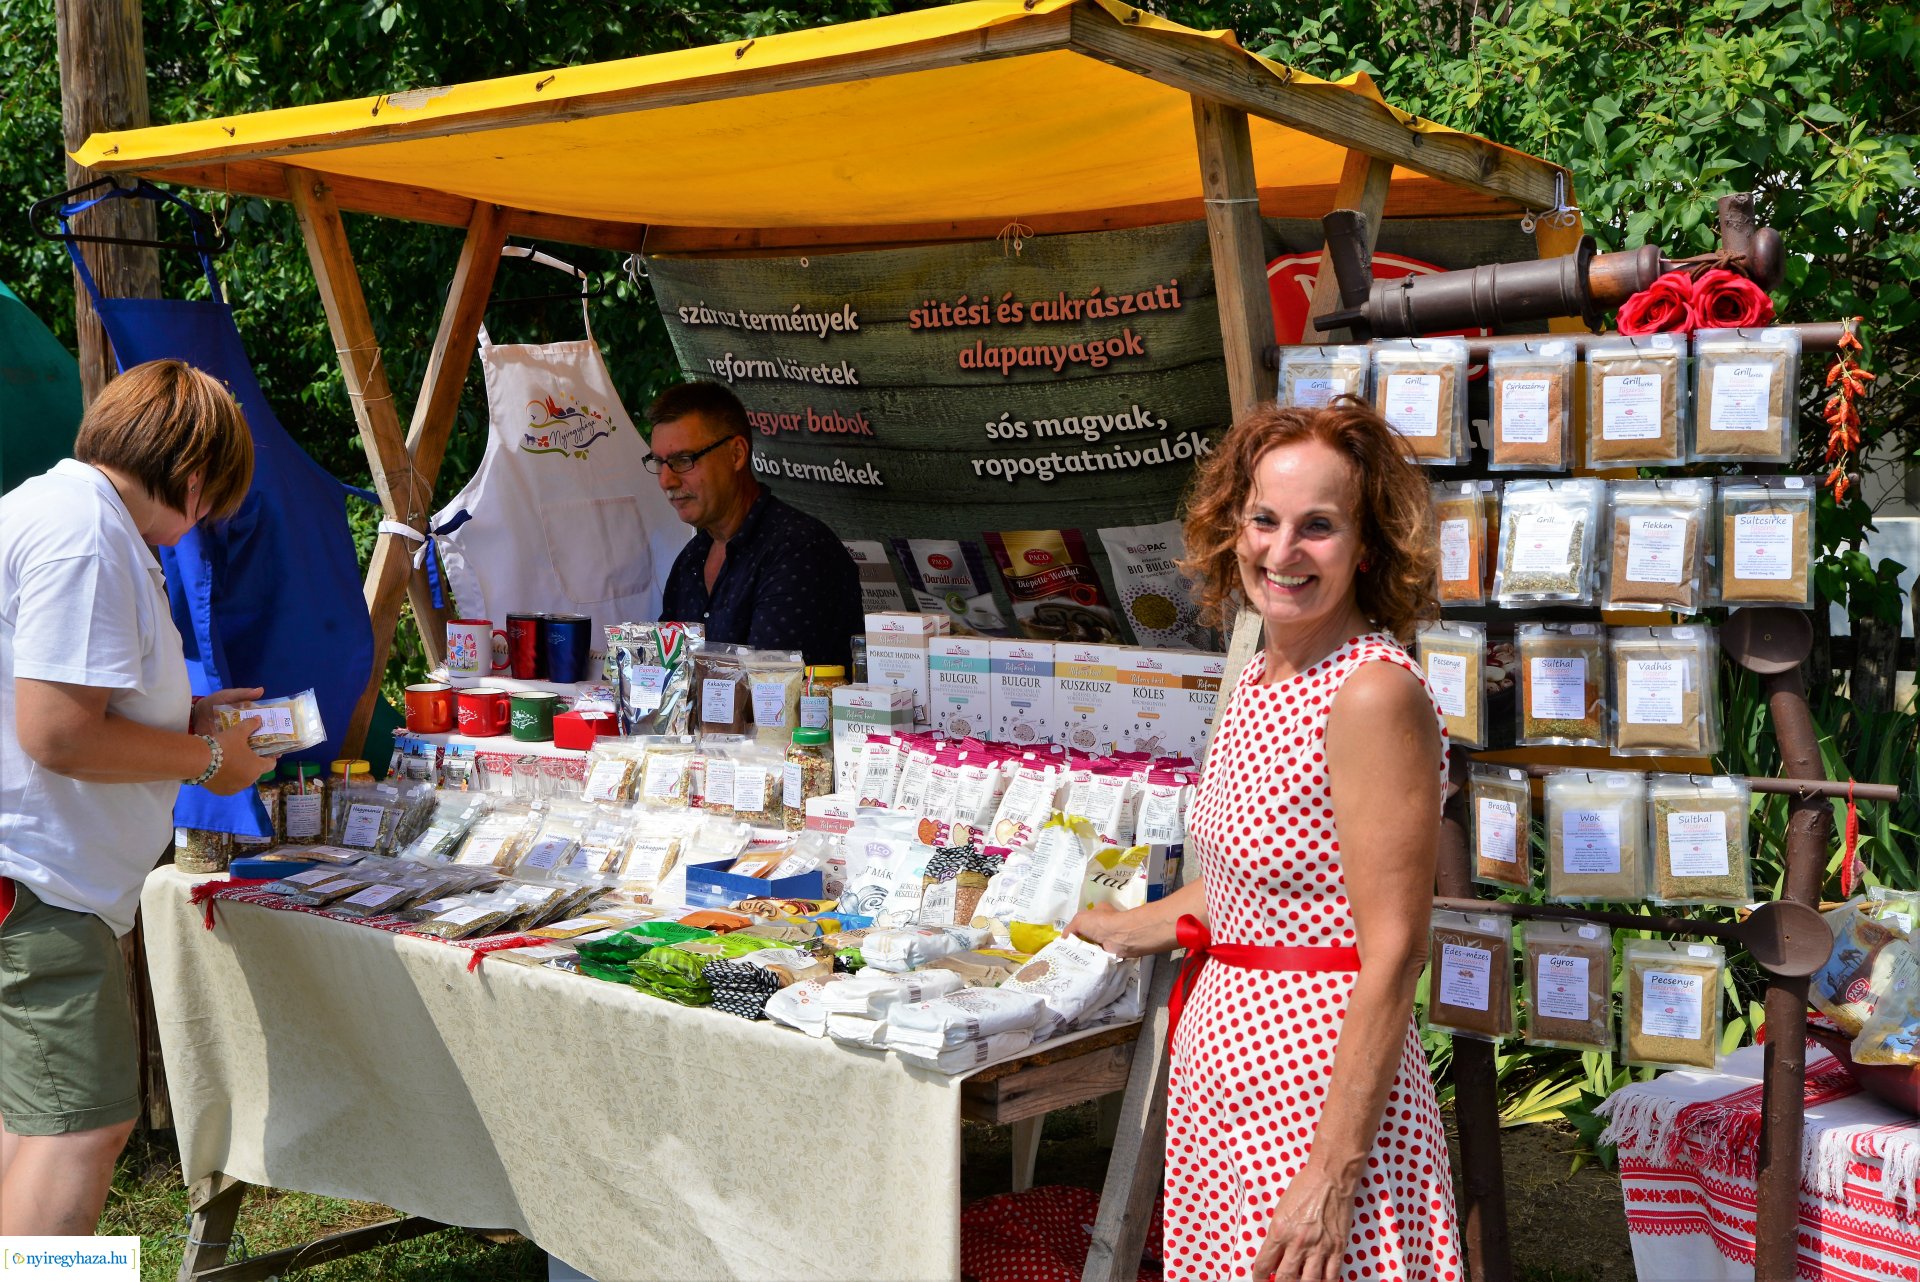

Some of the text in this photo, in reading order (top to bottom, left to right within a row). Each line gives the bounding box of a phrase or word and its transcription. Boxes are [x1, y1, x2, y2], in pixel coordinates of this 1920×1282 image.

[908, 278, 1182, 330] sütési és cukrászati
[678, 300, 860, 339] száraz termények
[958, 328, 1145, 375] alapanyagok
[706, 351, 860, 386] reform köretek
[1733, 368, 1752, 377] Grill
[1404, 376, 1422, 386] Grill
[1622, 377, 1641, 387] Grill
[747, 407, 874, 437] agyar babok
[984, 405, 1169, 440] sós magvak,
[971, 433, 1213, 482] ropogtatnivalók
[752, 450, 884, 487] bio termékek
[1536, 516, 1555, 524] Grill
[1642, 521, 1673, 529] Flekken
[1028, 554, 1049, 562] PACO
[1127, 564, 1144, 576] BIO
[1146, 559, 1180, 573] BULGU
[895, 651, 921, 660] HAJDINA
[1432, 656, 1461, 668] Pecsenye
[939, 672, 979, 685] BULGUR
[1001, 675, 1042, 688] BULGUR
[1060, 679, 1112, 694] KUSZKUSZ
[1132, 686, 1165, 700] KÖLES
[1188, 691, 1218, 705] KUSZ
[847, 722, 875, 735] KÖLES
[1579, 813, 1600, 823] Wok
[1678, 814, 1712, 825] Sülthal
[1549, 956, 1574, 968] Gyros
[1651, 975, 1696, 987] Pecsenye
[1848, 981, 1867, 1000] PACO
